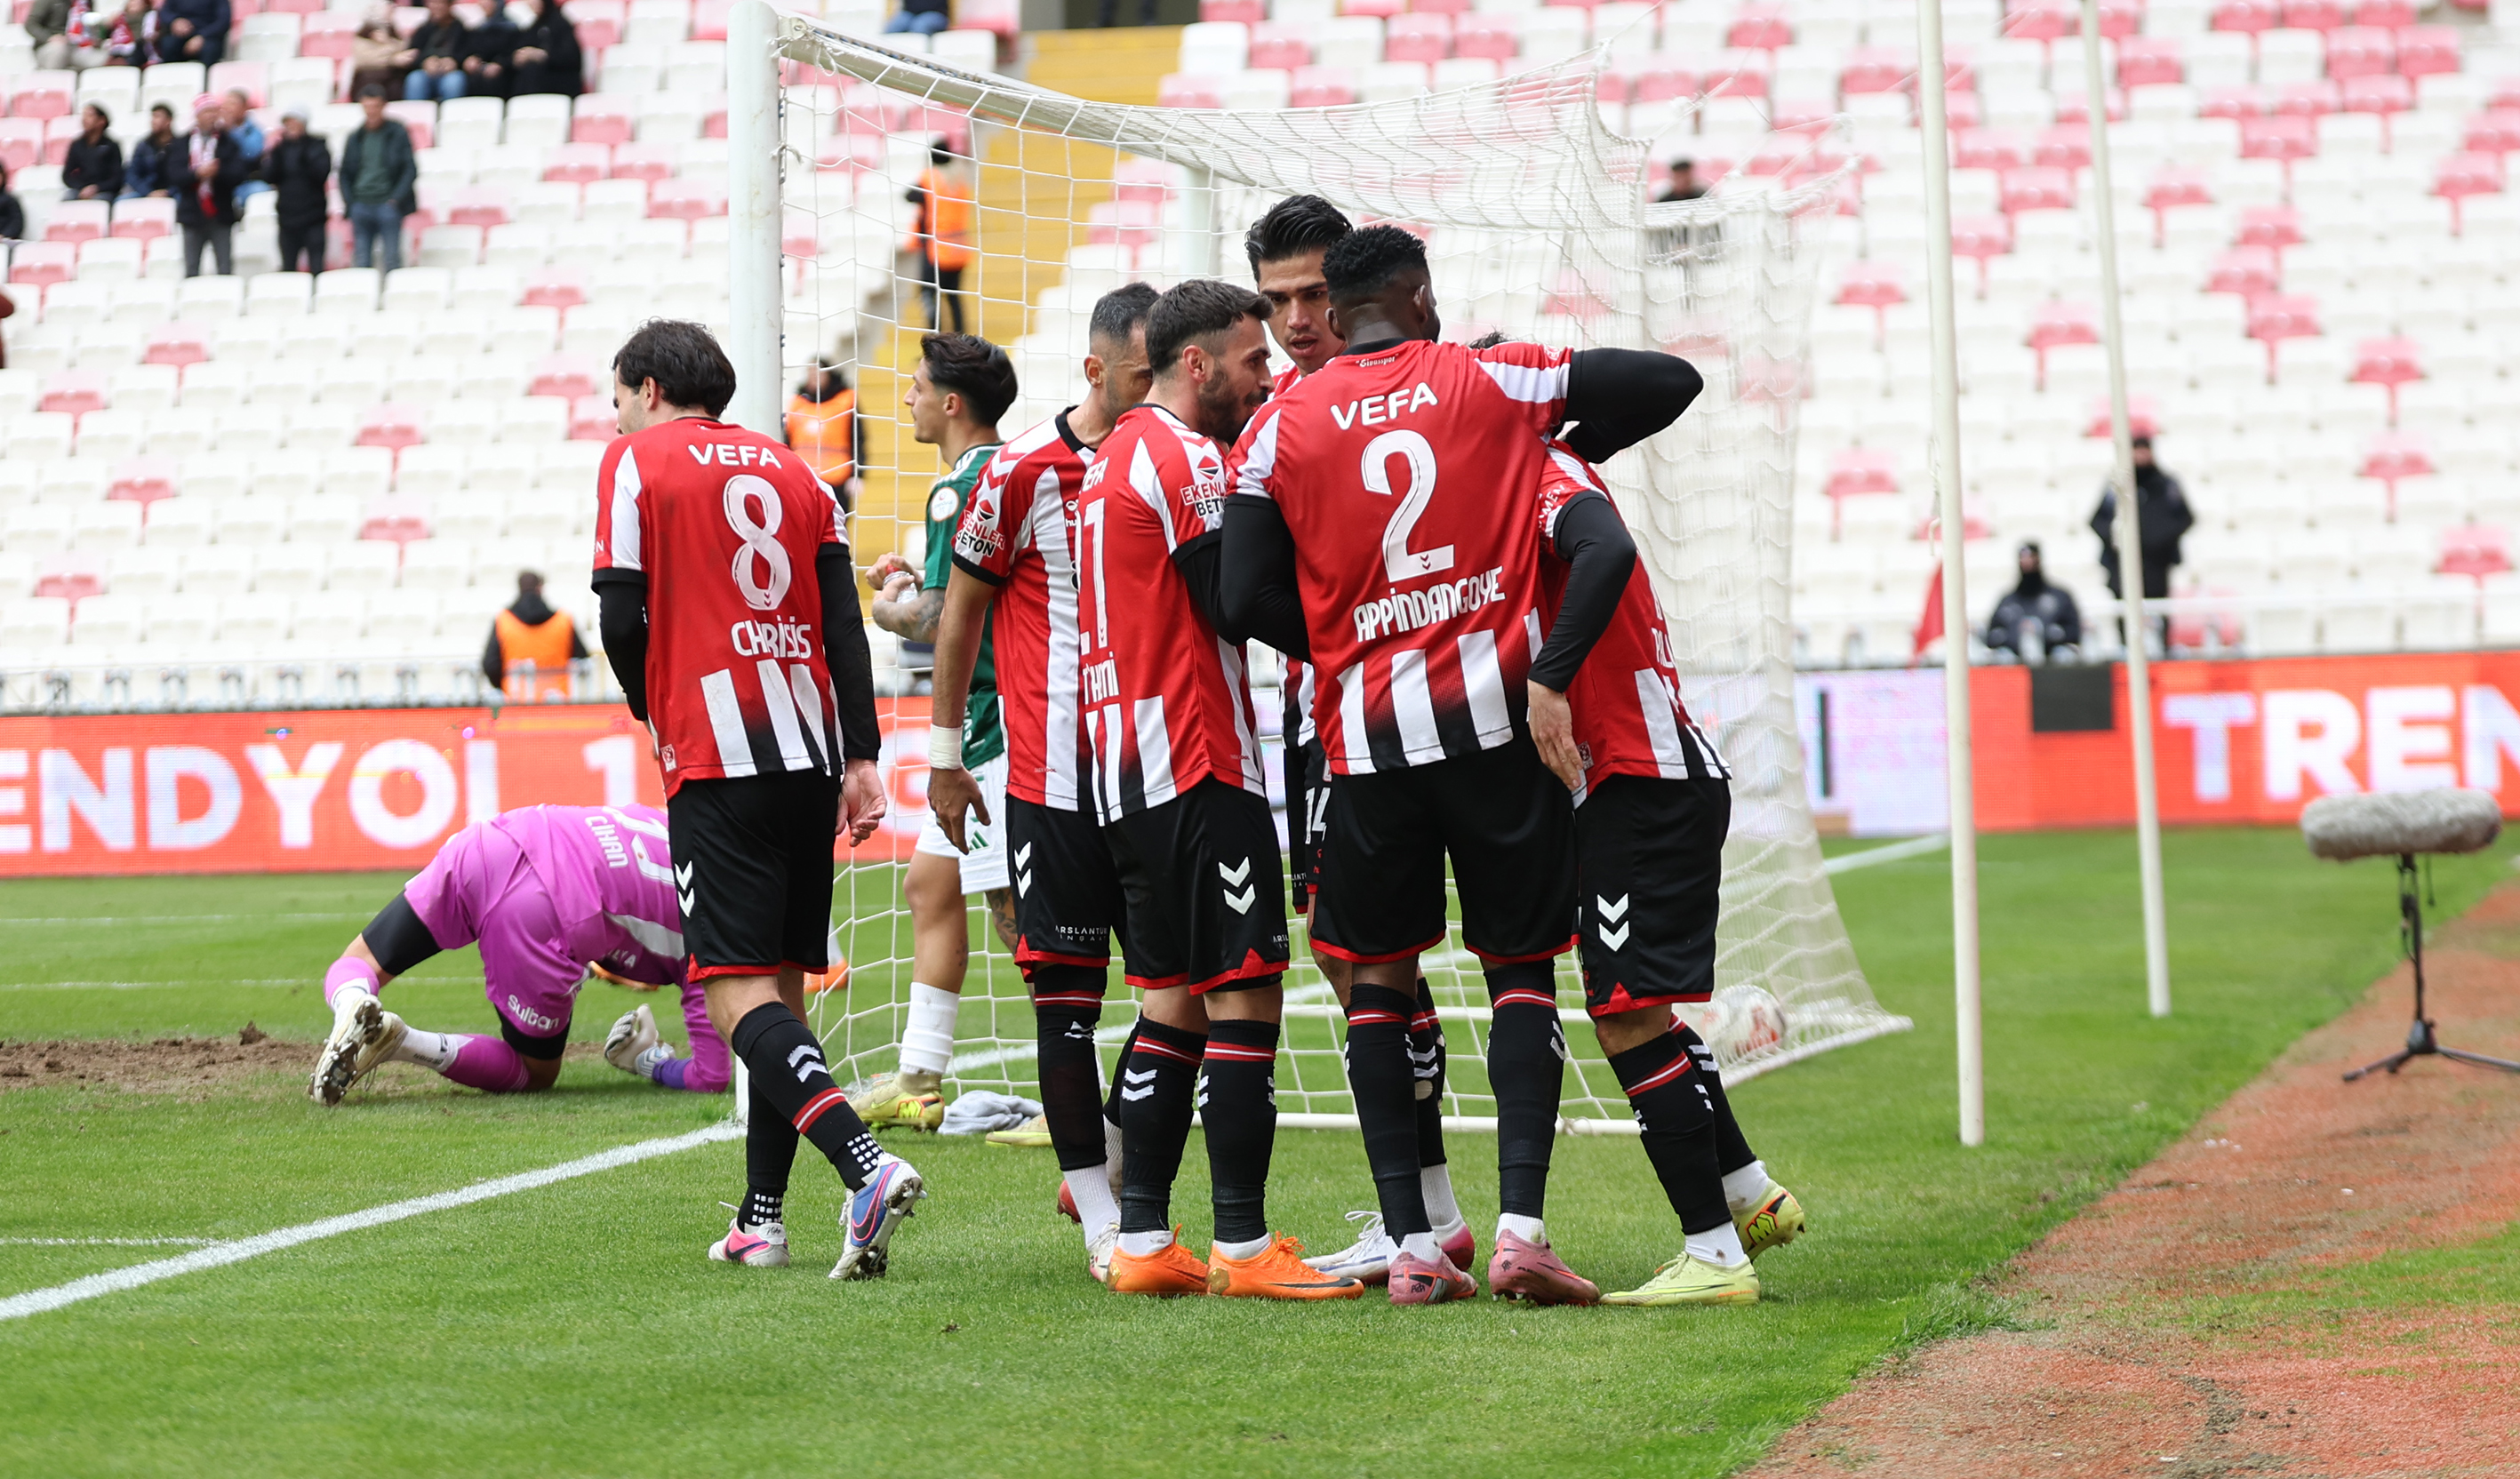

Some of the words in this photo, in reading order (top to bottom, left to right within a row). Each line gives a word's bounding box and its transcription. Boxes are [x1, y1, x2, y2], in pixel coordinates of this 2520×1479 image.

[1331, 382, 1438, 430] VEFA
[688, 443, 782, 469] VEFA
[1078, 456, 1109, 494] EFA
[1361, 428, 1454, 583] 2
[723, 474, 792, 611] 8
[508, 994, 560, 1029] Sultan
